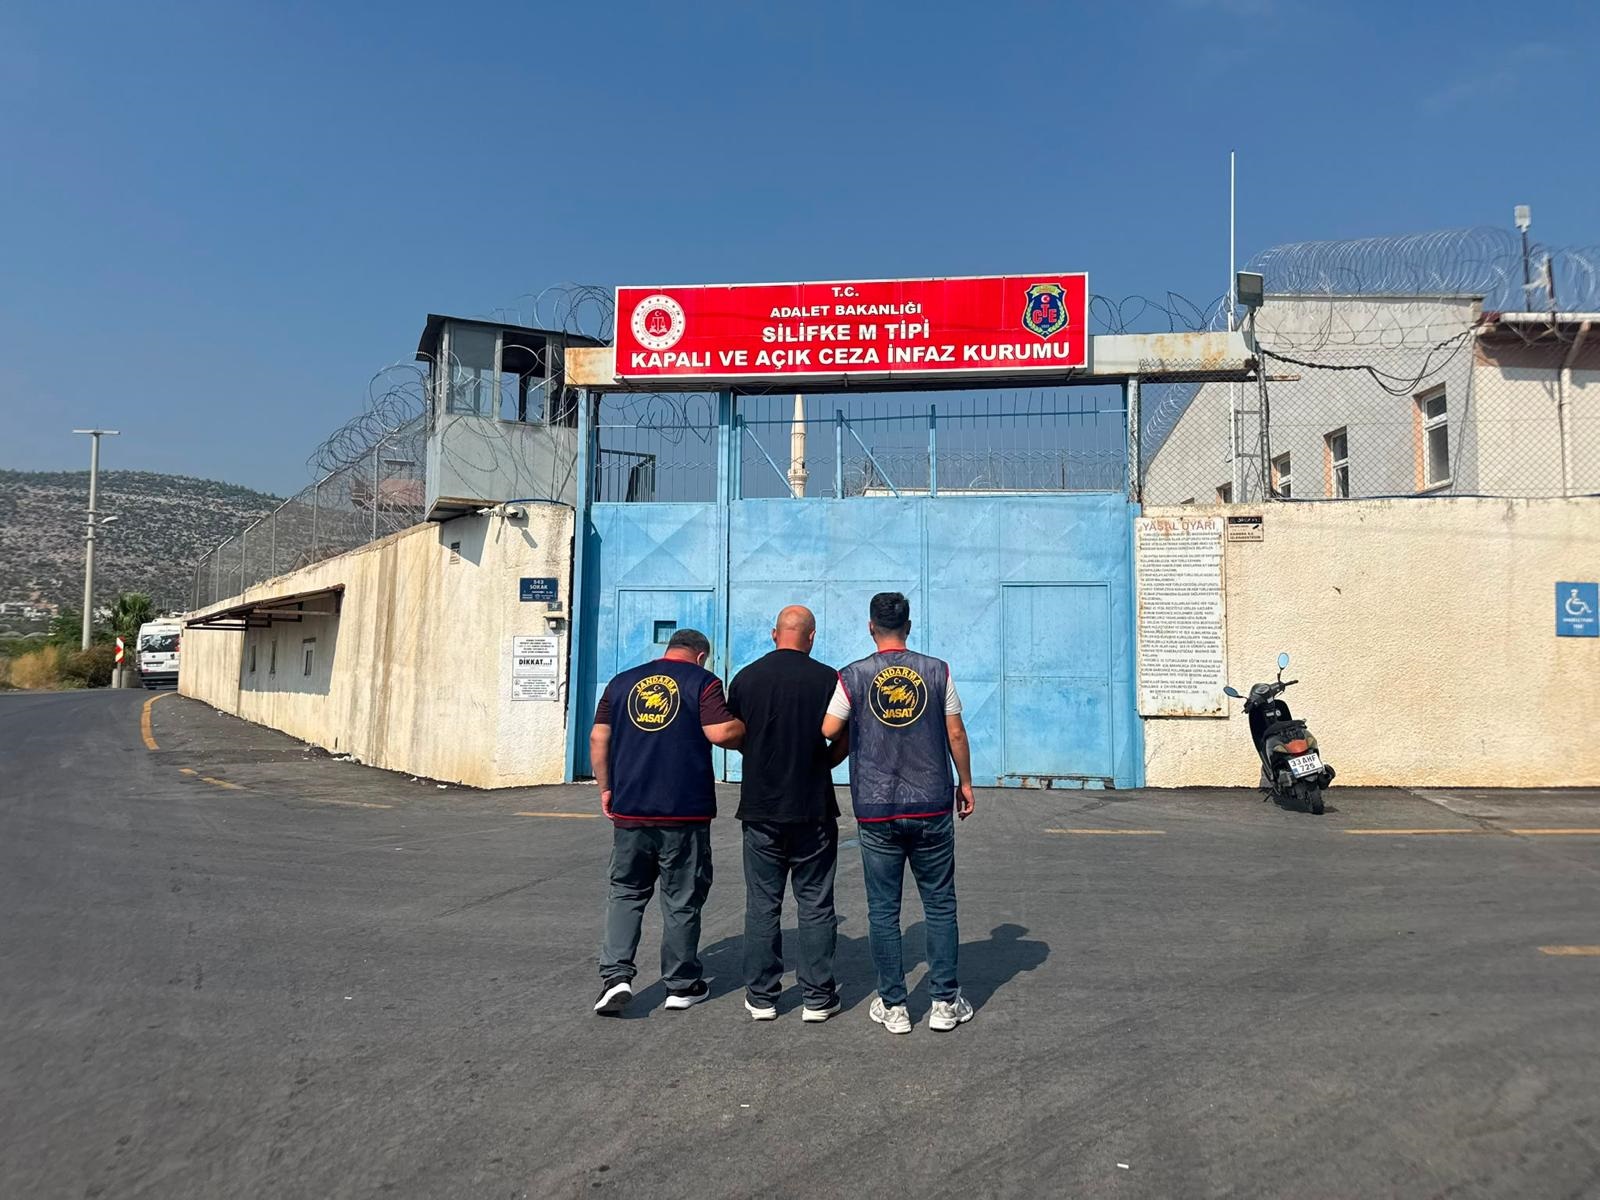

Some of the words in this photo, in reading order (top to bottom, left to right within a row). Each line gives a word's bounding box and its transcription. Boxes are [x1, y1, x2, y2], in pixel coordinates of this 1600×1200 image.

[832, 286, 860, 298] T.C.
[770, 305, 830, 318] ADALET
[835, 301, 922, 316] BAKANLIĞI
[762, 322, 851, 343] SİLİFKE
[858, 324, 877, 341] M
[884, 318, 930, 340] TİPİ
[631, 351, 711, 369] KAPALI
[718, 350, 748, 367] VE
[755, 349, 812, 370] AÇIK
[818, 347, 880, 365] CEZA
[887, 343, 956, 364] İNFAZ
[963, 341, 1070, 362] KURUMU
[1142, 521, 1179, 531] YASAL
[636, 676, 677, 695] JANDARMA
[874, 668, 922, 688] JANDARMA
[637, 713, 665, 723] JASAT
[882, 708, 914, 719] JASAT
